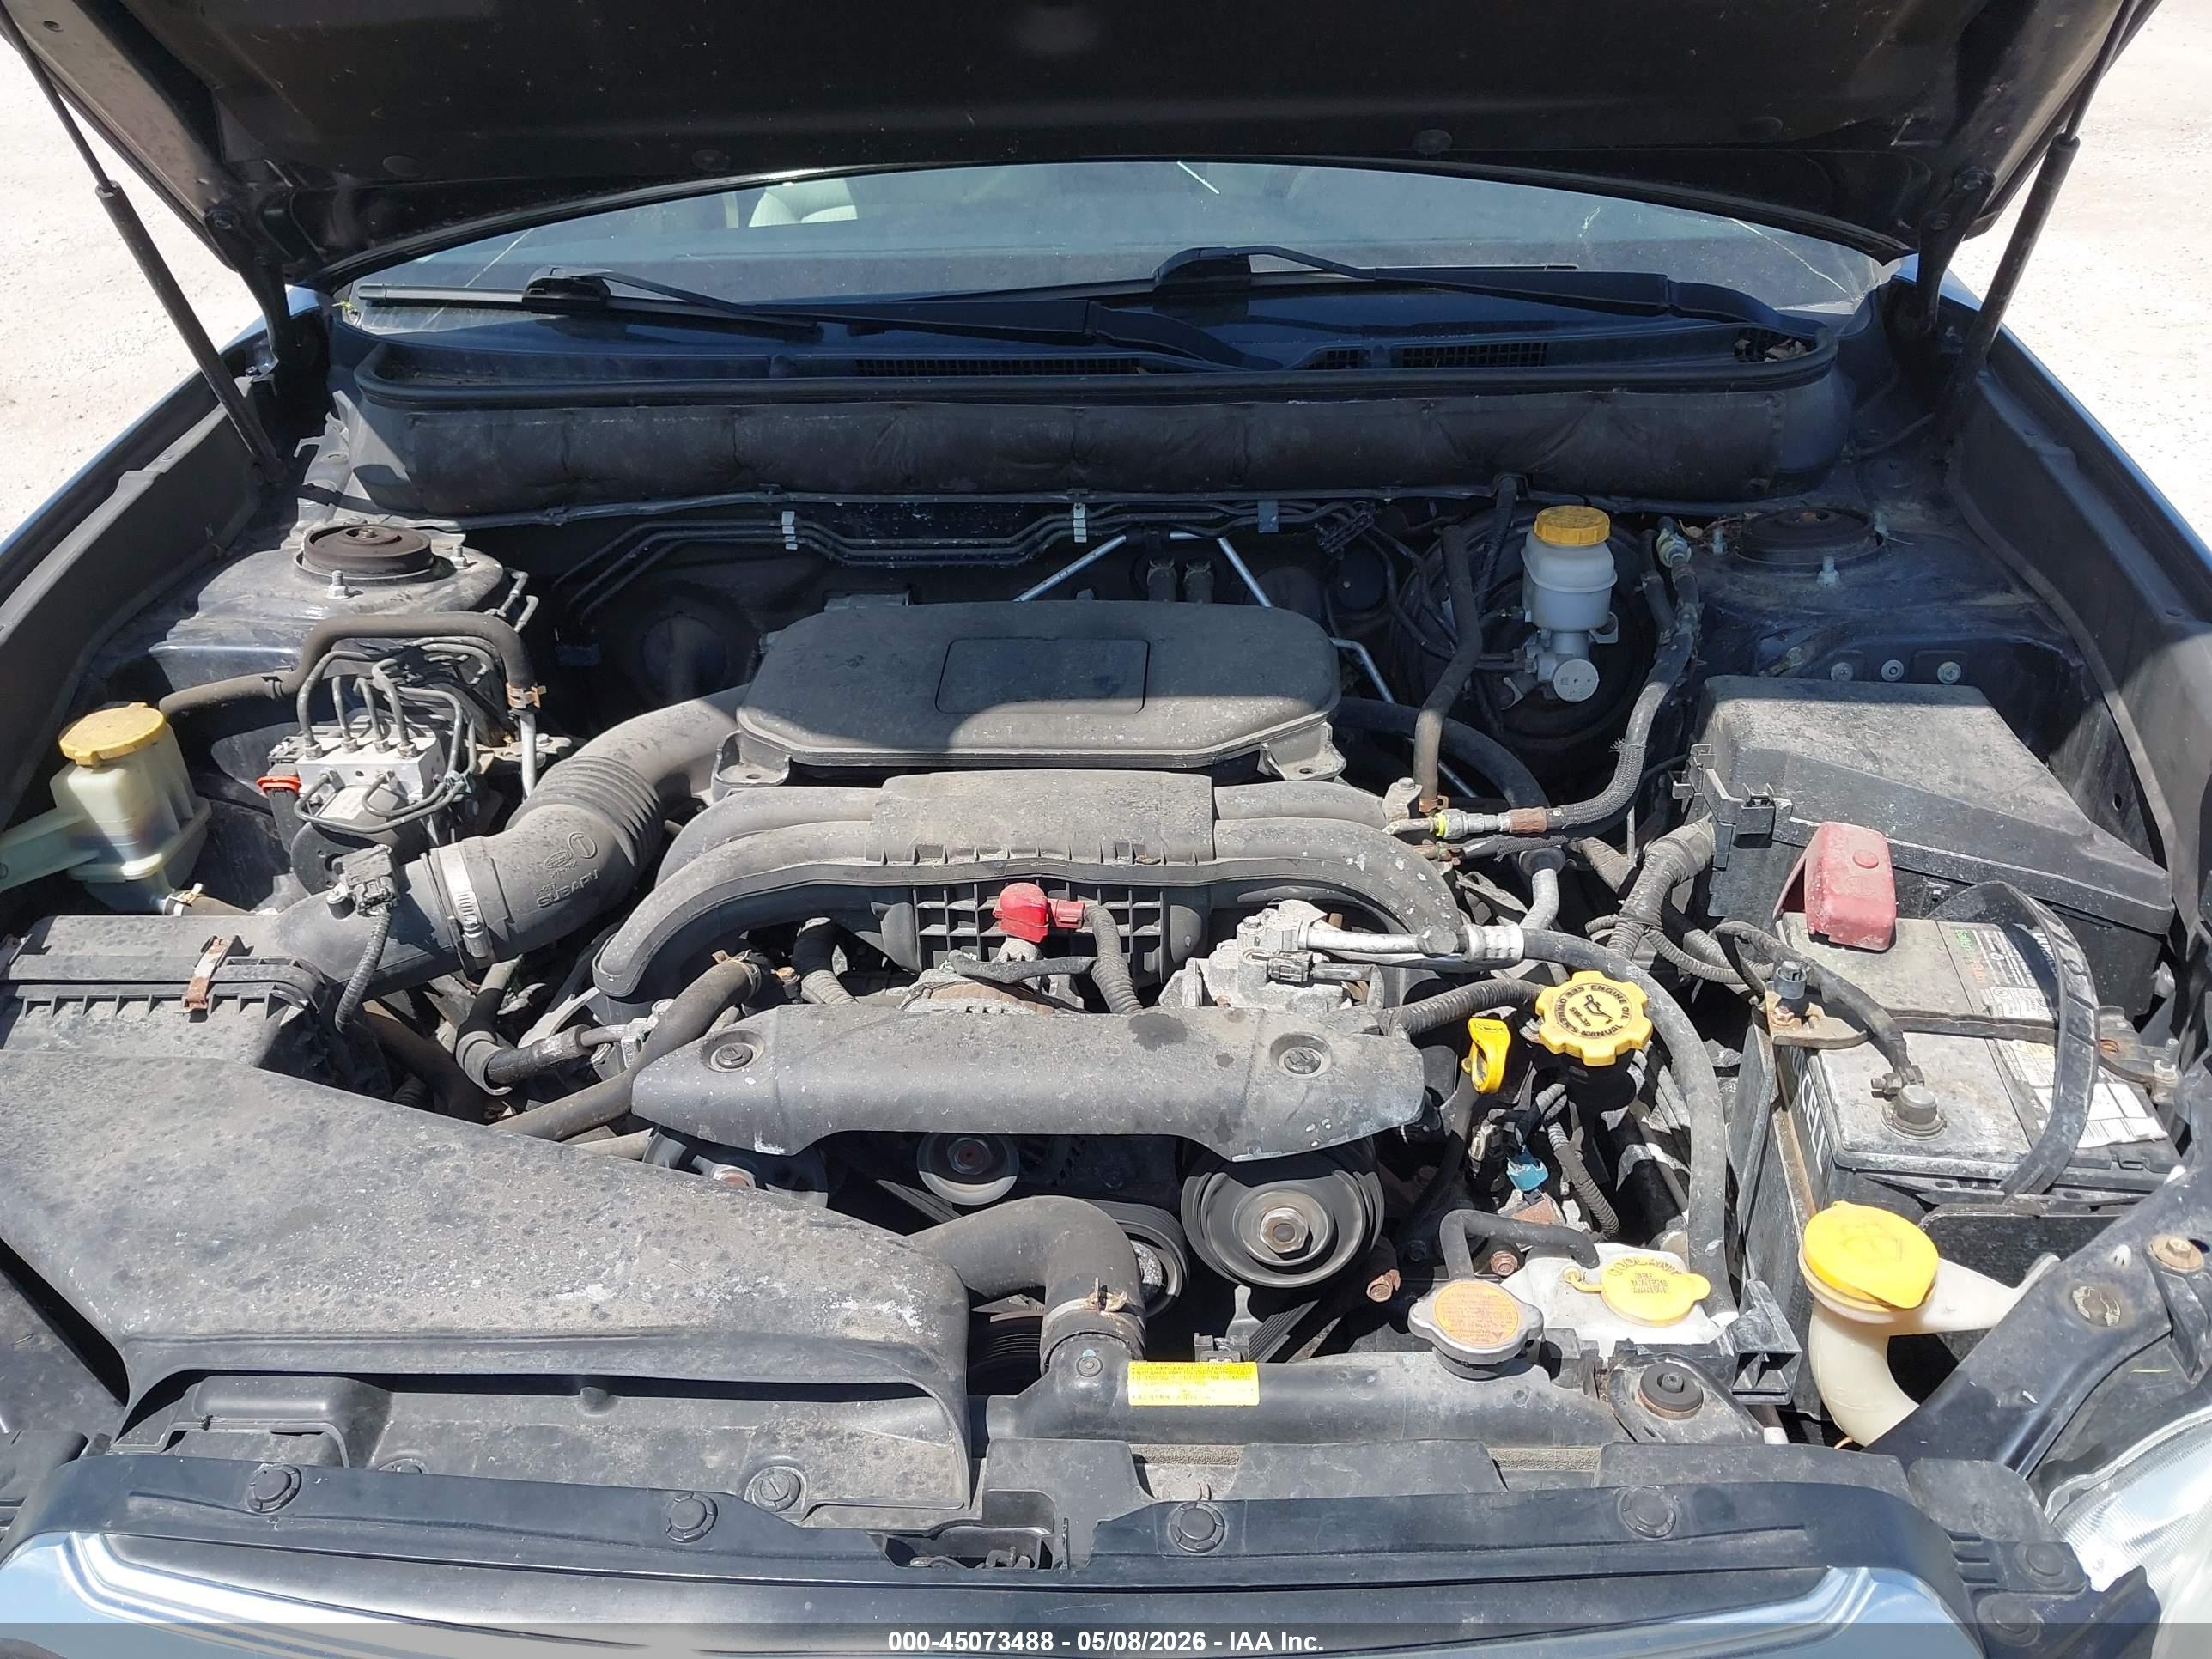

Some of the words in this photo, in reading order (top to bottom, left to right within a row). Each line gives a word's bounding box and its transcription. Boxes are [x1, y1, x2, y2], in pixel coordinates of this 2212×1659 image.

[1565, 986, 1585, 998] SEE
[1580, 1024, 1623, 1037] MANUAL
[1590, 984, 1627, 1004] ENGINE
[1621, 1006, 1630, 1019] OIL
[1569, 1006, 1591, 1027] 5W-30
[1607, 1256, 1682, 1276] COOLANT
